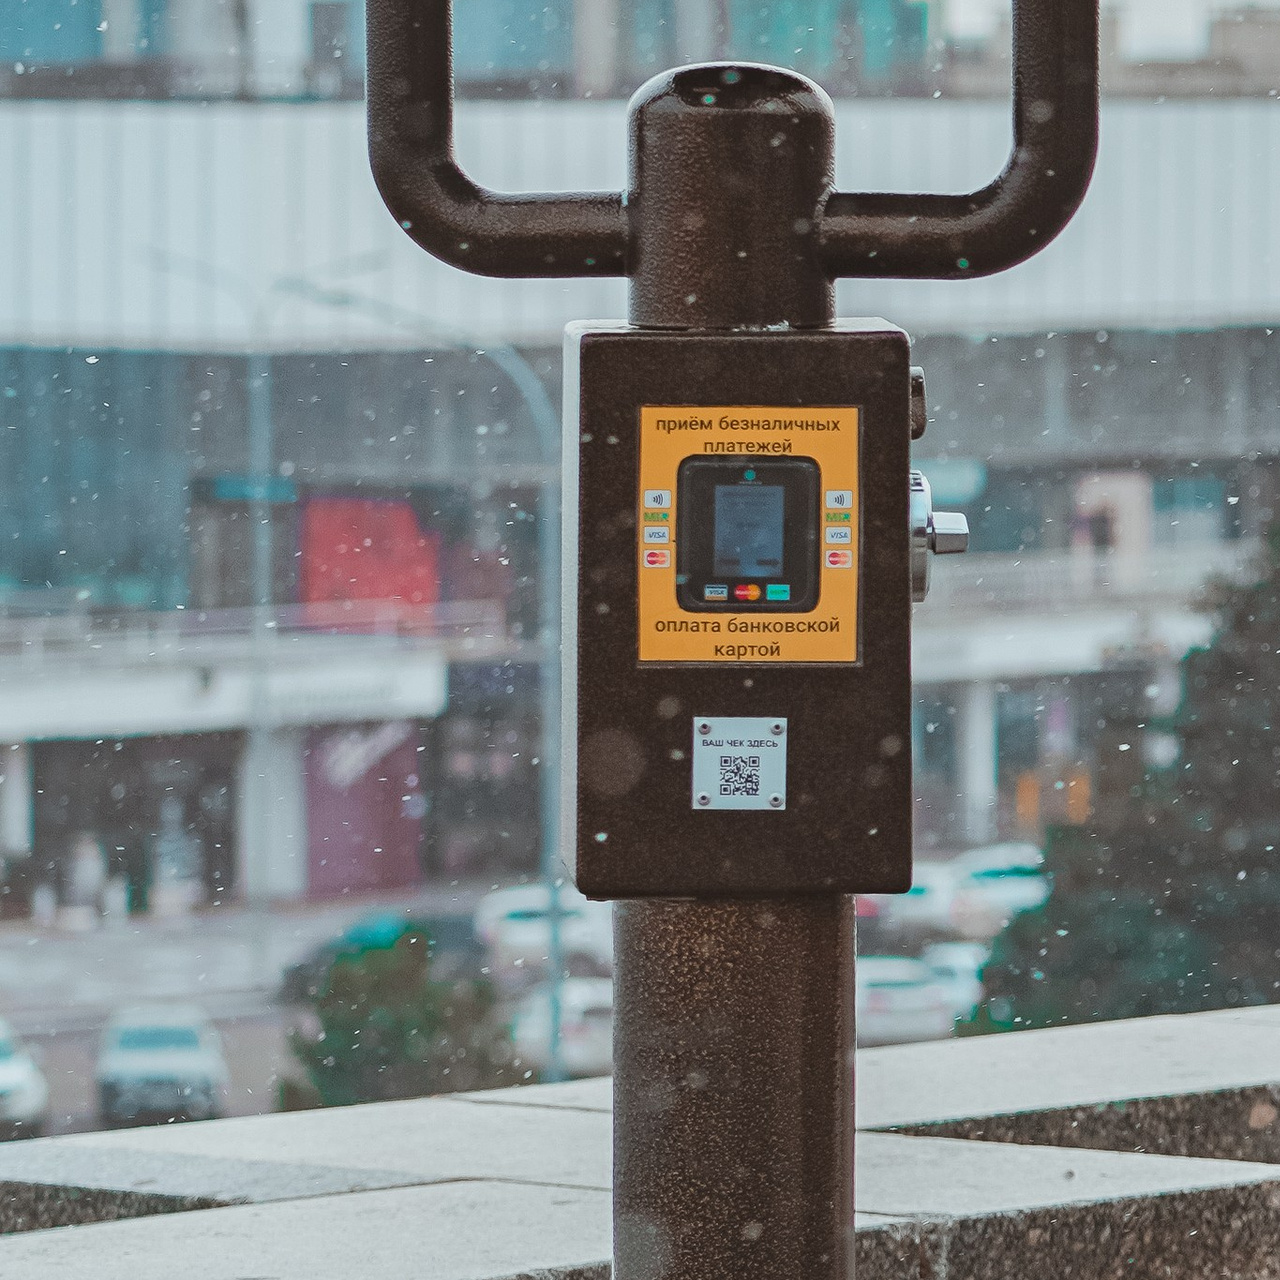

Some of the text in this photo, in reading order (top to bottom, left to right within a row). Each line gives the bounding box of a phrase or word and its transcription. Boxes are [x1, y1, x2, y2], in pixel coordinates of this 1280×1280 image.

[656, 416, 841, 434] приём безналичных
[703, 439, 792, 453] платежей
[655, 617, 840, 633] оплата банковской
[714, 641, 781, 660] картой
[702, 739, 779, 748] ВАШ ЧЕК ЗДЕСЬ
